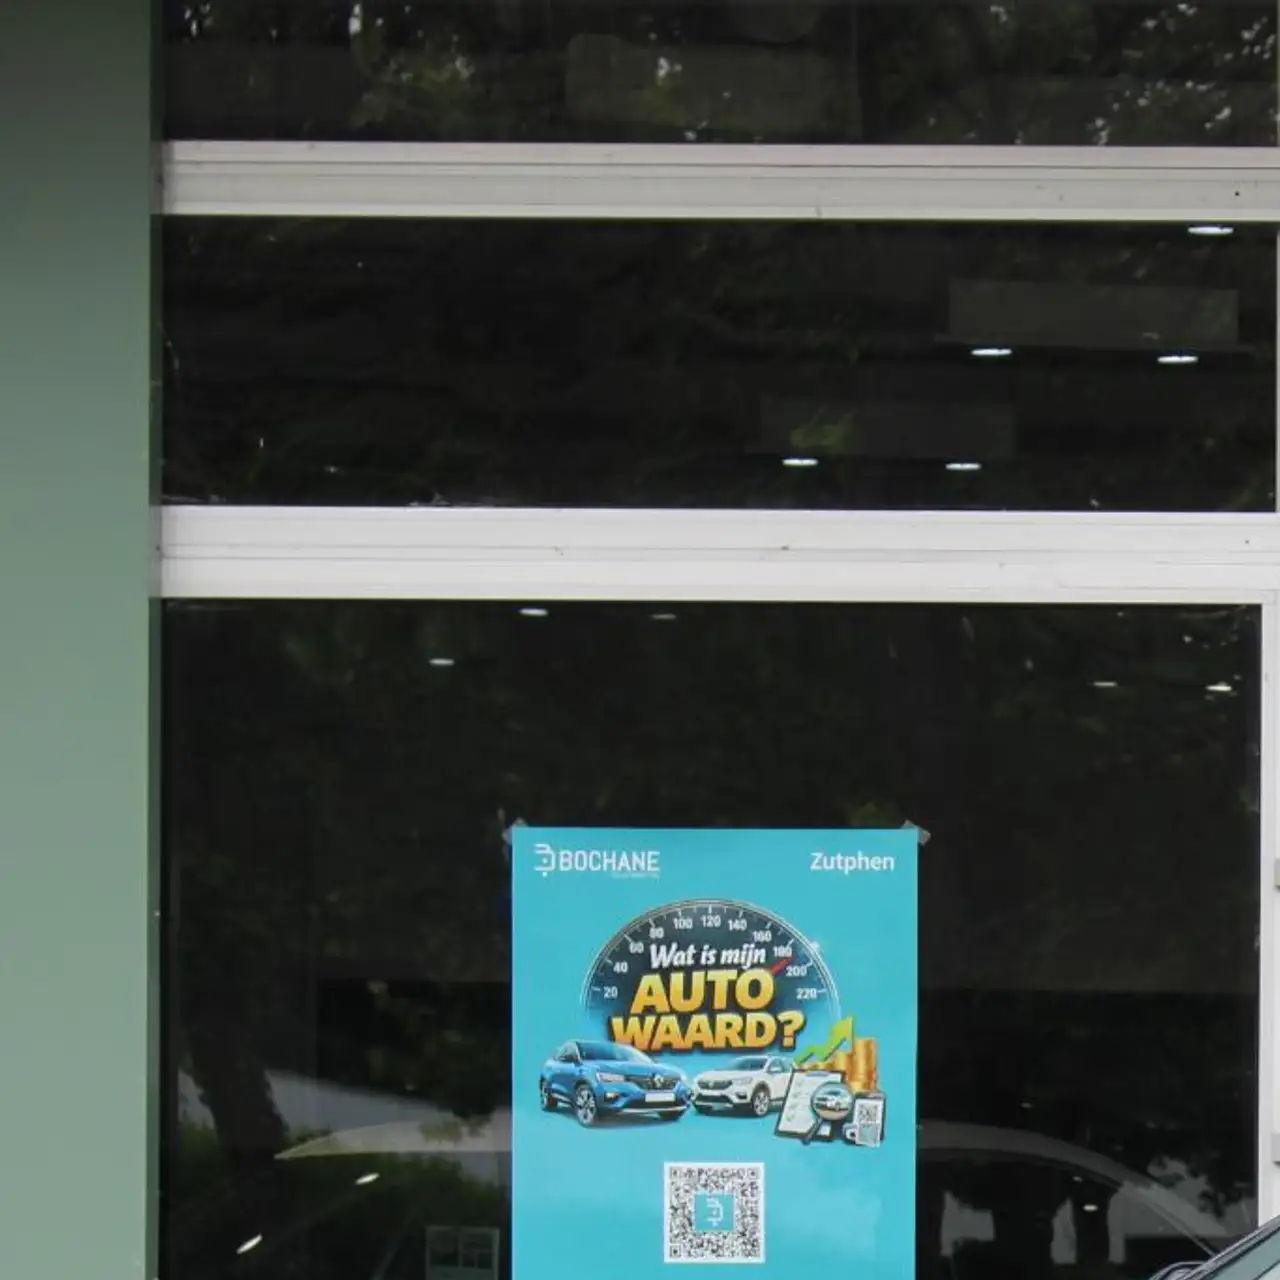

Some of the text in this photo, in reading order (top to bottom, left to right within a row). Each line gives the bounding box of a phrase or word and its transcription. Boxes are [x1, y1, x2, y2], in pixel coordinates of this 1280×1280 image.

[559, 851, 660, 871] BOCHANE
[810, 852, 895, 875] Zutphen
[673, 918, 693, 930] 100
[700, 915, 721, 927] 120
[728, 919, 747, 931] 140
[650, 942, 766, 969] Wat is mijn
[614, 962, 628, 973] 40
[786, 965, 807, 976] 200
[603, 986, 618, 998] 20
[630, 968, 775, 1014] AUTO
[796, 988, 817, 999] 220
[611, 1010, 805, 1051] WAARD?
